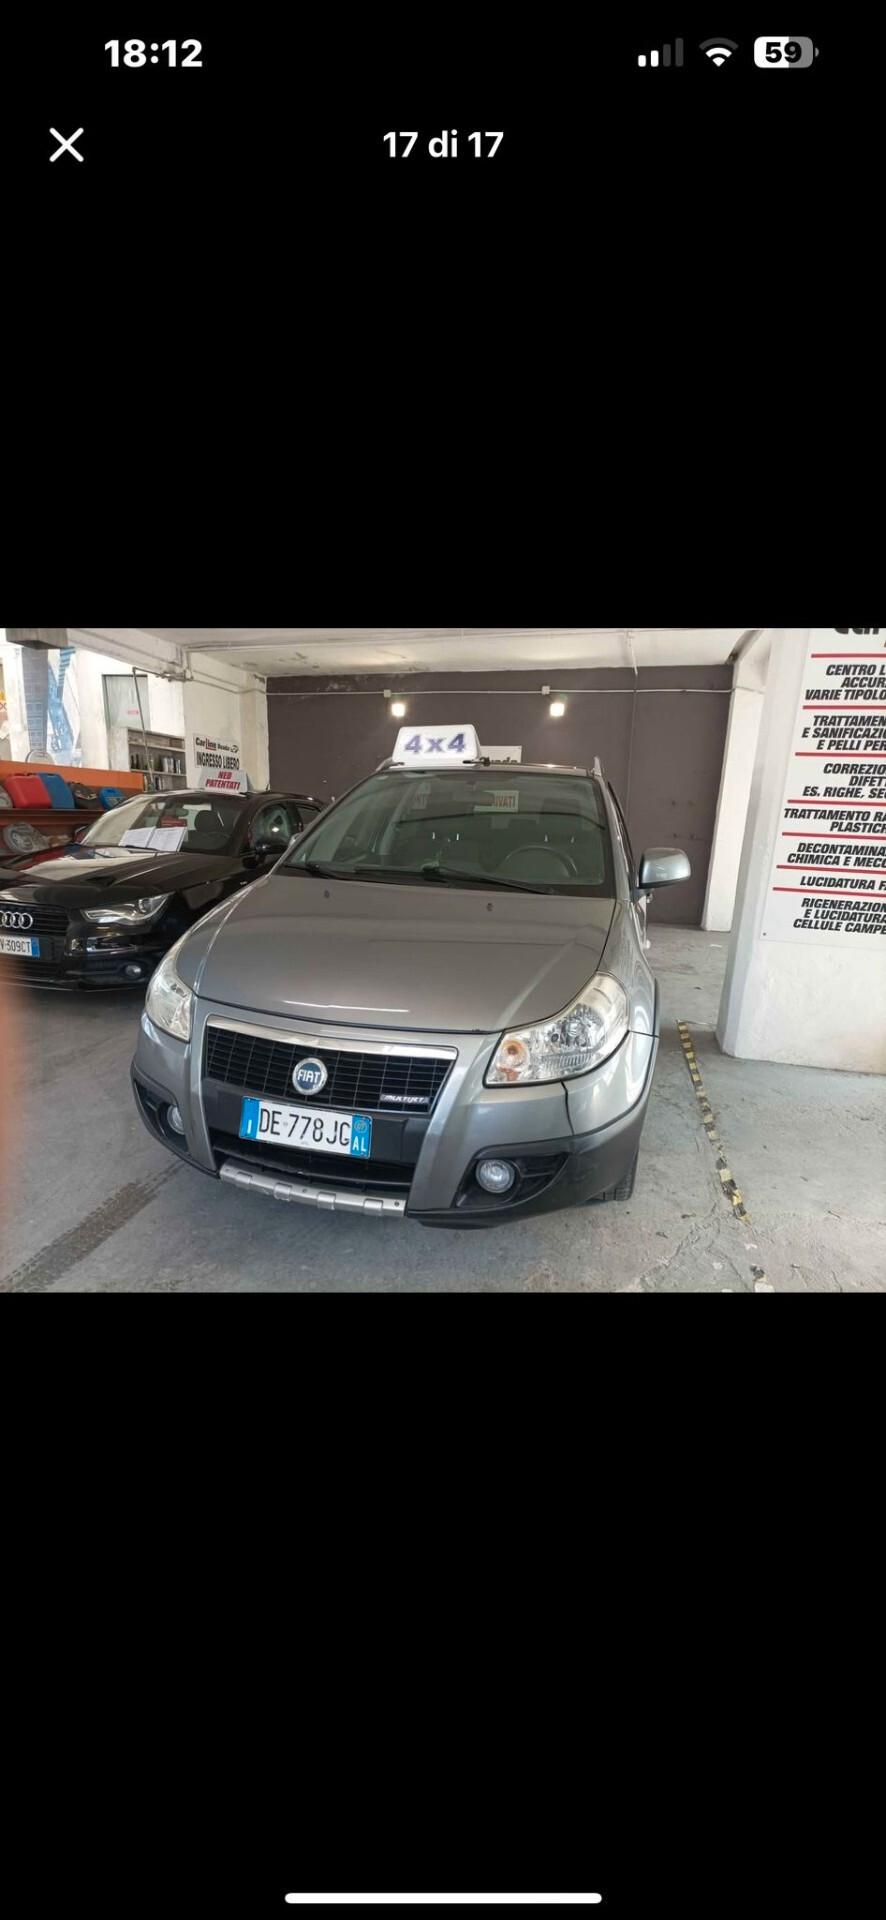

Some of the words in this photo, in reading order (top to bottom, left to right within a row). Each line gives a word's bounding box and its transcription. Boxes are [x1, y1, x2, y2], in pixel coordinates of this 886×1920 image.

[826, 664, 877, 675] CENTRO
[841, 677, 886, 688] ACCUR
[805, 689, 842, 700] VARIE
[802, 727, 810, 738] E
[816, 740, 825, 750] E
[827, 740, 861, 750] PELLI
[196, 751, 222, 768] INGRESSO
[223, 755, 240, 771] LIBERO
[205, 779, 241, 790] PATENTATI
[802, 786, 821, 797] ES.
[823, 787, 865, 799] RIGHE,
[784, 808, 871, 822] TRATTAMENTO
[787, 853, 840, 866] CHIMICA
[842, 856, 852, 867] E
[800, 876, 876, 890] LUCIDATURA
[804, 909, 812, 919] E
[793, 918, 843, 932] CELLULE
[297, 1070, 321, 1084] FIAT
[258, 1107, 283, 1137] DE
[287, 1113, 351, 1147] 778JG
[352, 1135, 367, 1152] AL
